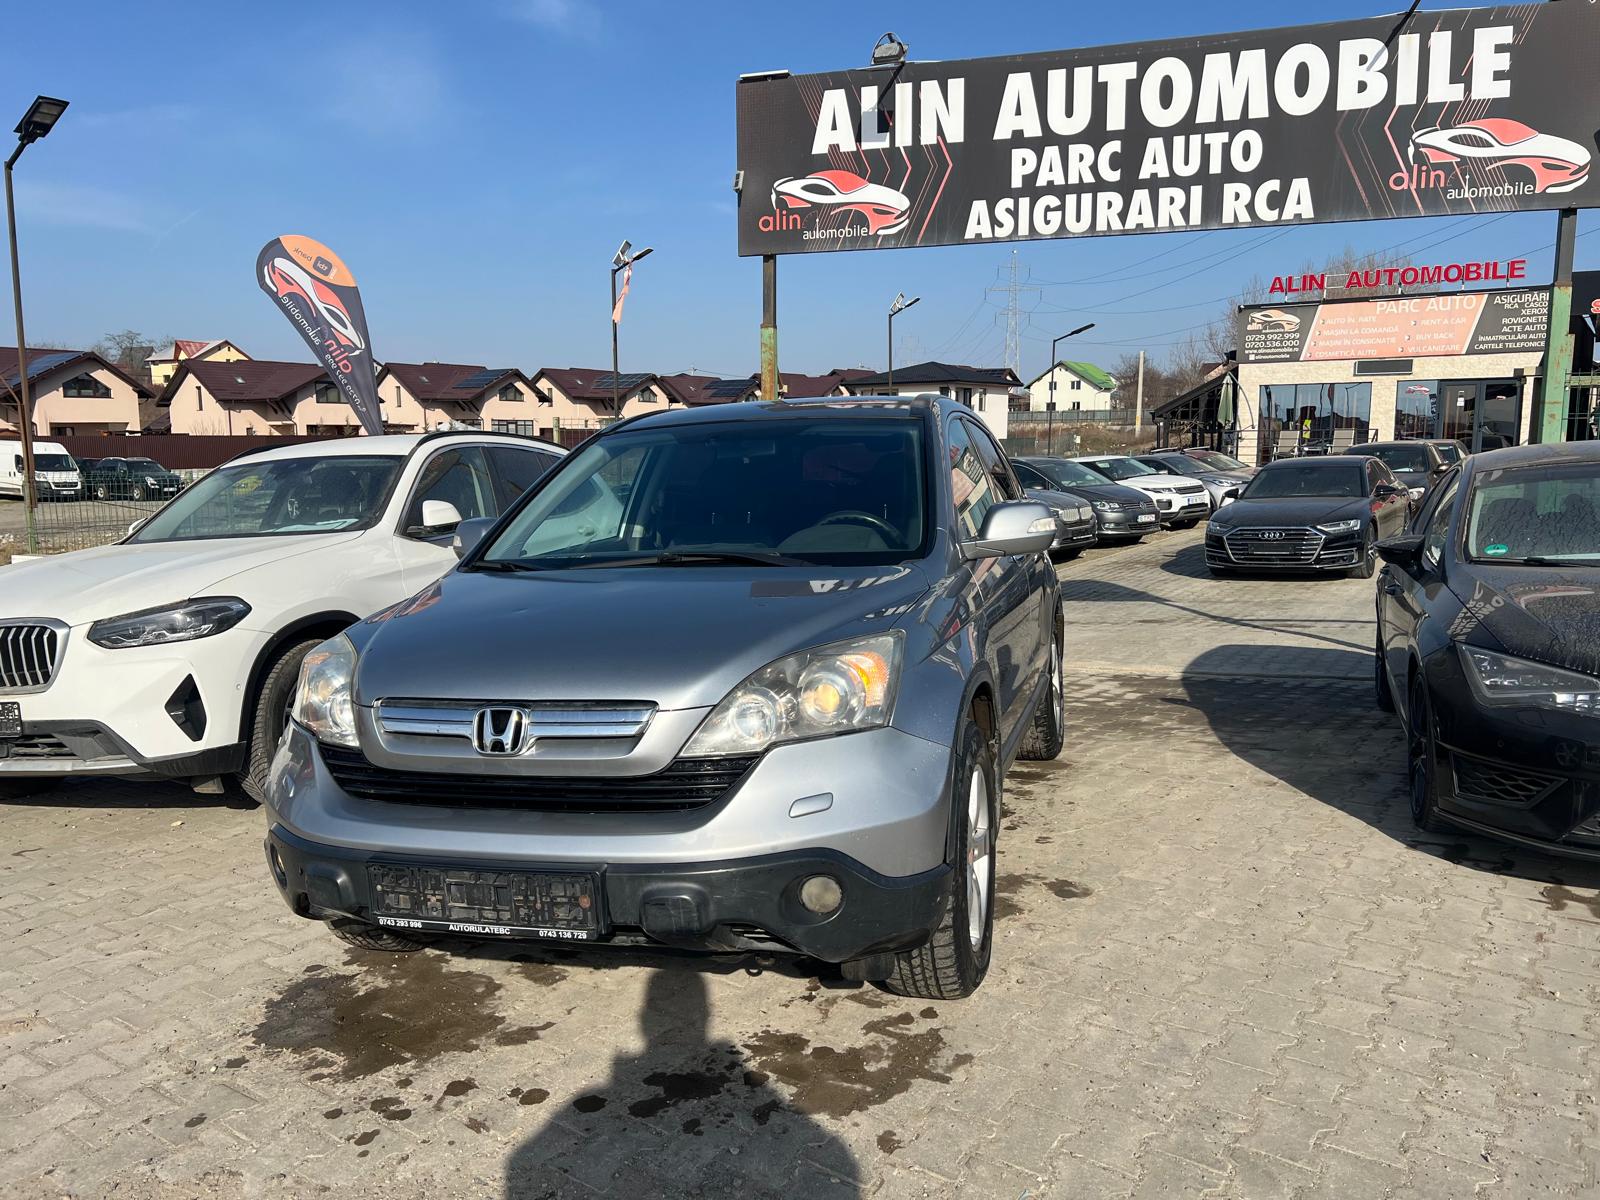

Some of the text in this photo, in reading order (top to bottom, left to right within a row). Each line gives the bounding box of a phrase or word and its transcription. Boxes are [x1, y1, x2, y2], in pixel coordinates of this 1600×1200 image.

[812, 25, 1514, 155] ALIN AUTOMOBILE
[1010, 129, 1264, 189] PARC AUTO
[1388, 163, 1448, 191] alin
[964, 178, 1315, 241] ASIGURARI RCA
[758, 208, 801, 232] alin
[1268, 259, 1527, 293] ALIN AUTOMOBILE
[1494, 291, 1550, 305] ASIGURĂRI
[1376, 295, 1476, 315] PARC AUTO
[1520, 307, 1548, 316] XEROX
[1502, 315, 1548, 325] ROVIGNETE
[1501, 324, 1547, 333] ACTE AUTO
[1245, 332, 1300, 342] 0729.992.999
[1245, 340, 1300, 349] 0720.536.000
[1474, 342, 1503, 350] CARTELE
[378, 918, 422, 929] 0743 293 996
[448, 924, 511, 936] AUTORULATEBC
[539, 930, 587, 940] 0743 136 729
